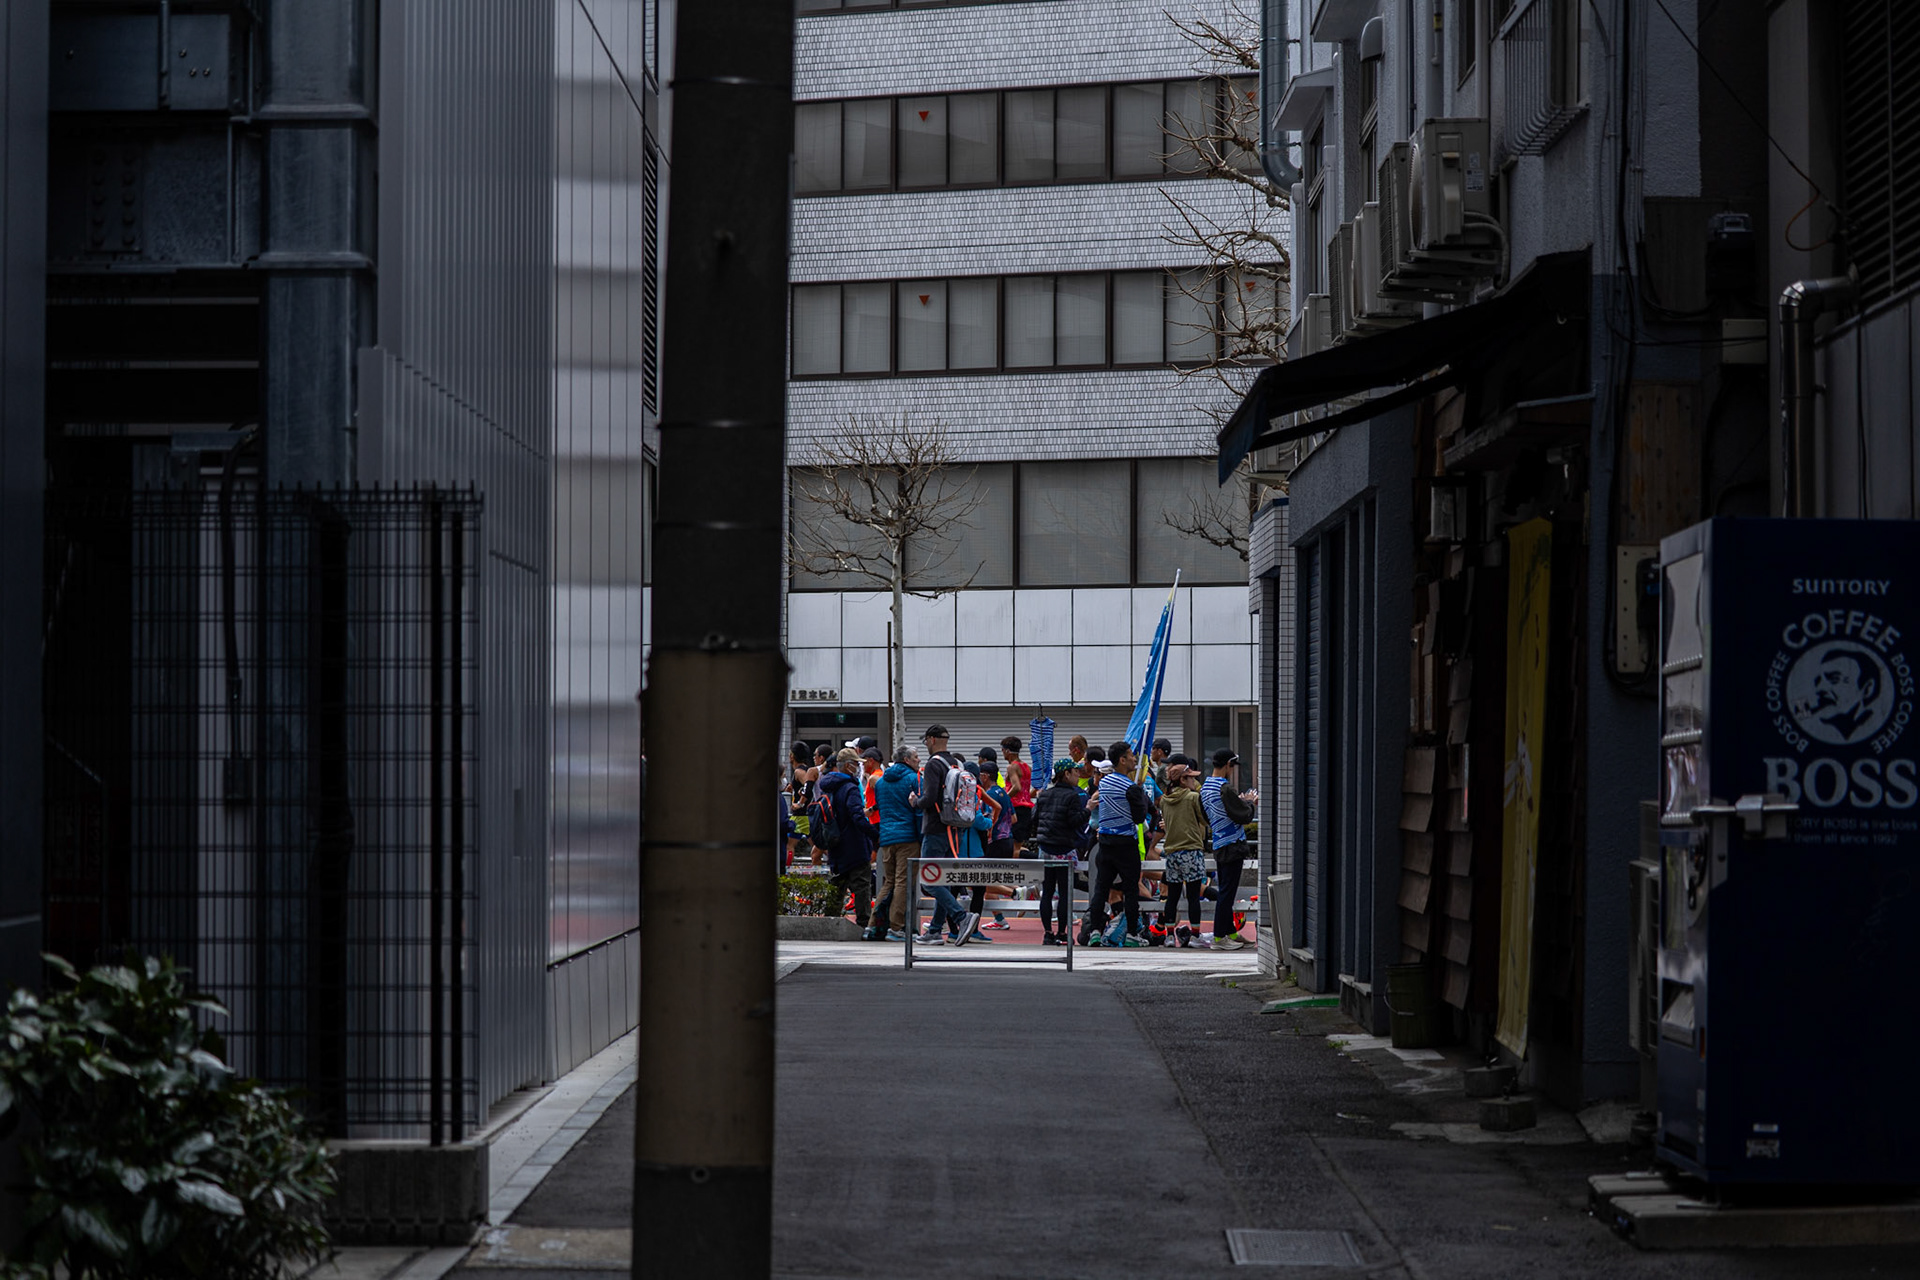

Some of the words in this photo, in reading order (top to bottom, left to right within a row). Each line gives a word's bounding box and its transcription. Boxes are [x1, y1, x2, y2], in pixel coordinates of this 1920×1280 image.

[1792, 577, 1891, 597] SUNTORY
[1782, 609, 1902, 653] COFFEE
[1765, 650, 1791, 712] COFFEE
[1890, 652, 1915, 696] BOSS
[1772, 714, 1809, 753] BOSS
[1870, 701, 1913, 755] COFFEE
[1762, 756, 1919, 810] BOSS
[945, 872, 1025, 884] 交通規制実施中
